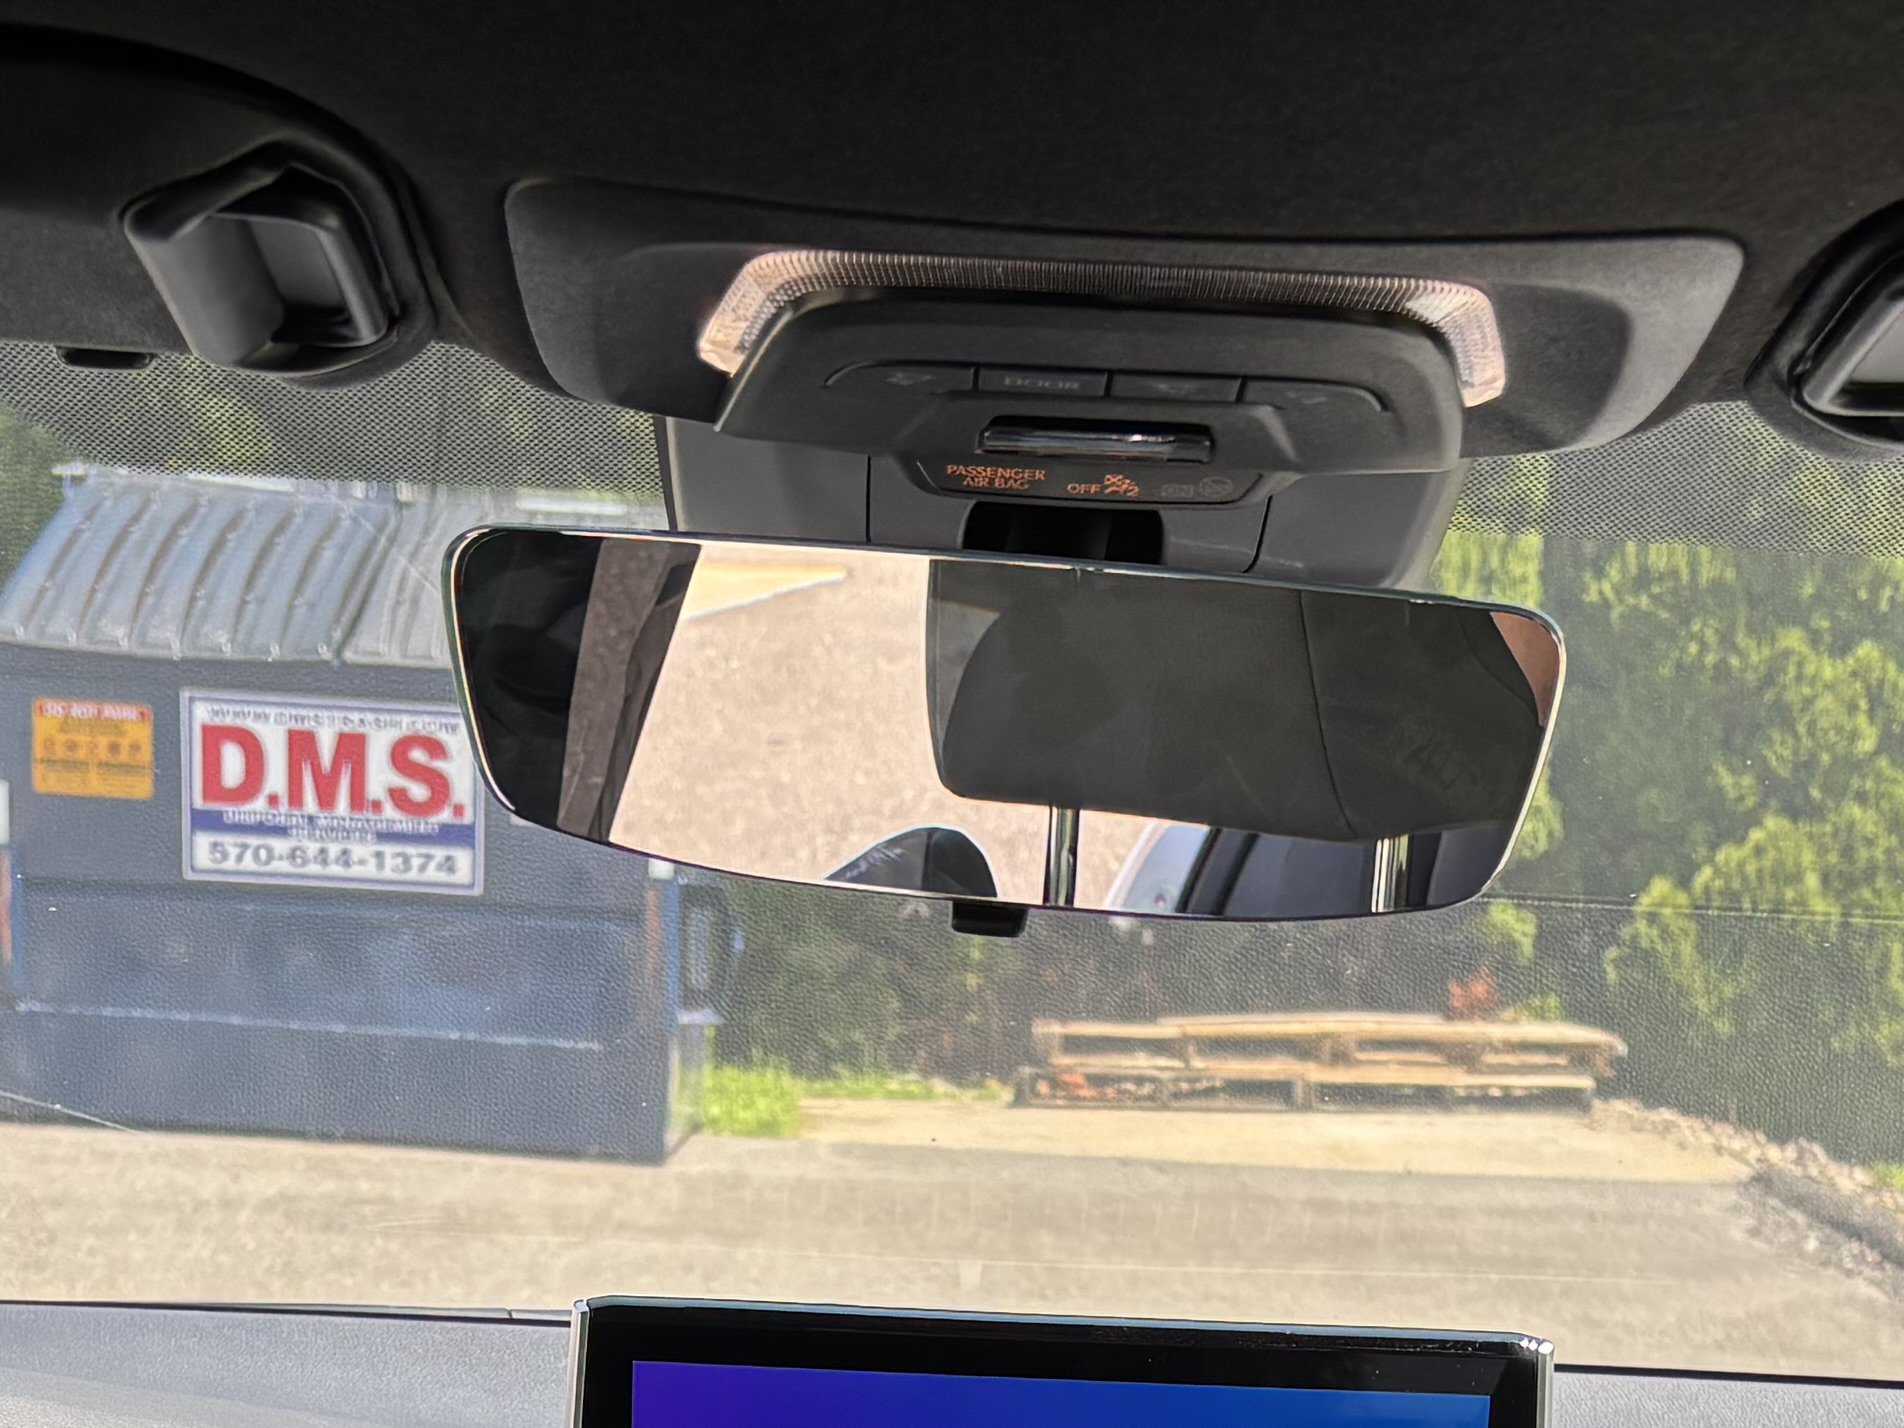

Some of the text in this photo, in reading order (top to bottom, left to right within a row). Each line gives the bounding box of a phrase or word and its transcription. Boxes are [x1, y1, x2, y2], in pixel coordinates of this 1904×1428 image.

[946, 464, 1046, 481] PASSENGER
[963, 476, 1030, 490] AIR BAG
[1067, 483, 1101, 495] OFF
[200, 724, 466, 820] D.M.S.
[208, 840, 457, 875] 570-644-1374
